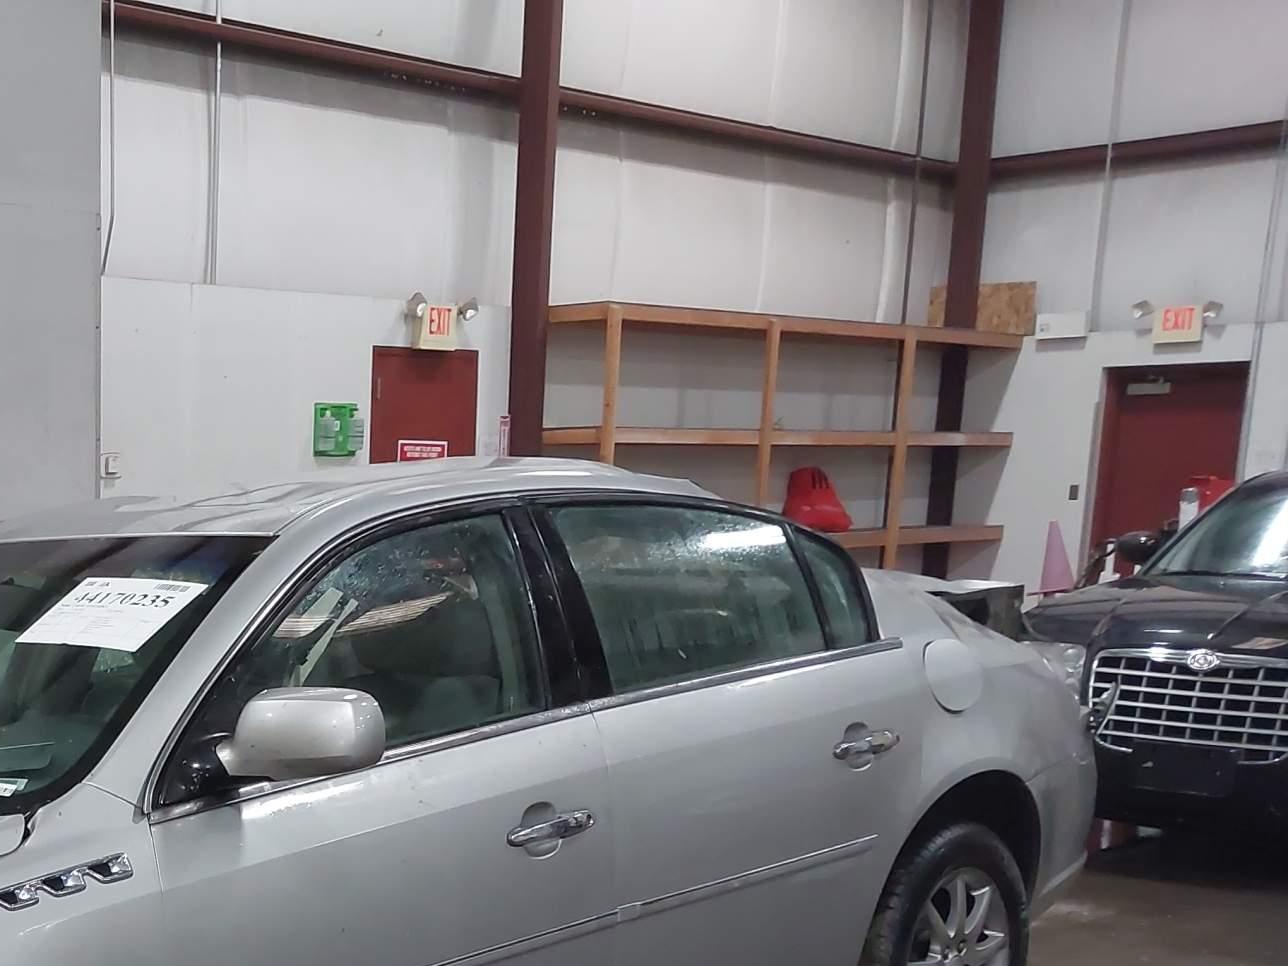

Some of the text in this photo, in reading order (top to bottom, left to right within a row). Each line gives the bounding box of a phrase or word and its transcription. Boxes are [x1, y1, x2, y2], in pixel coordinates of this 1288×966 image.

[429, 308, 452, 336] EXIT
[1163, 307, 1195, 331] EXIT
[74, 591, 176, 608] 44170235
